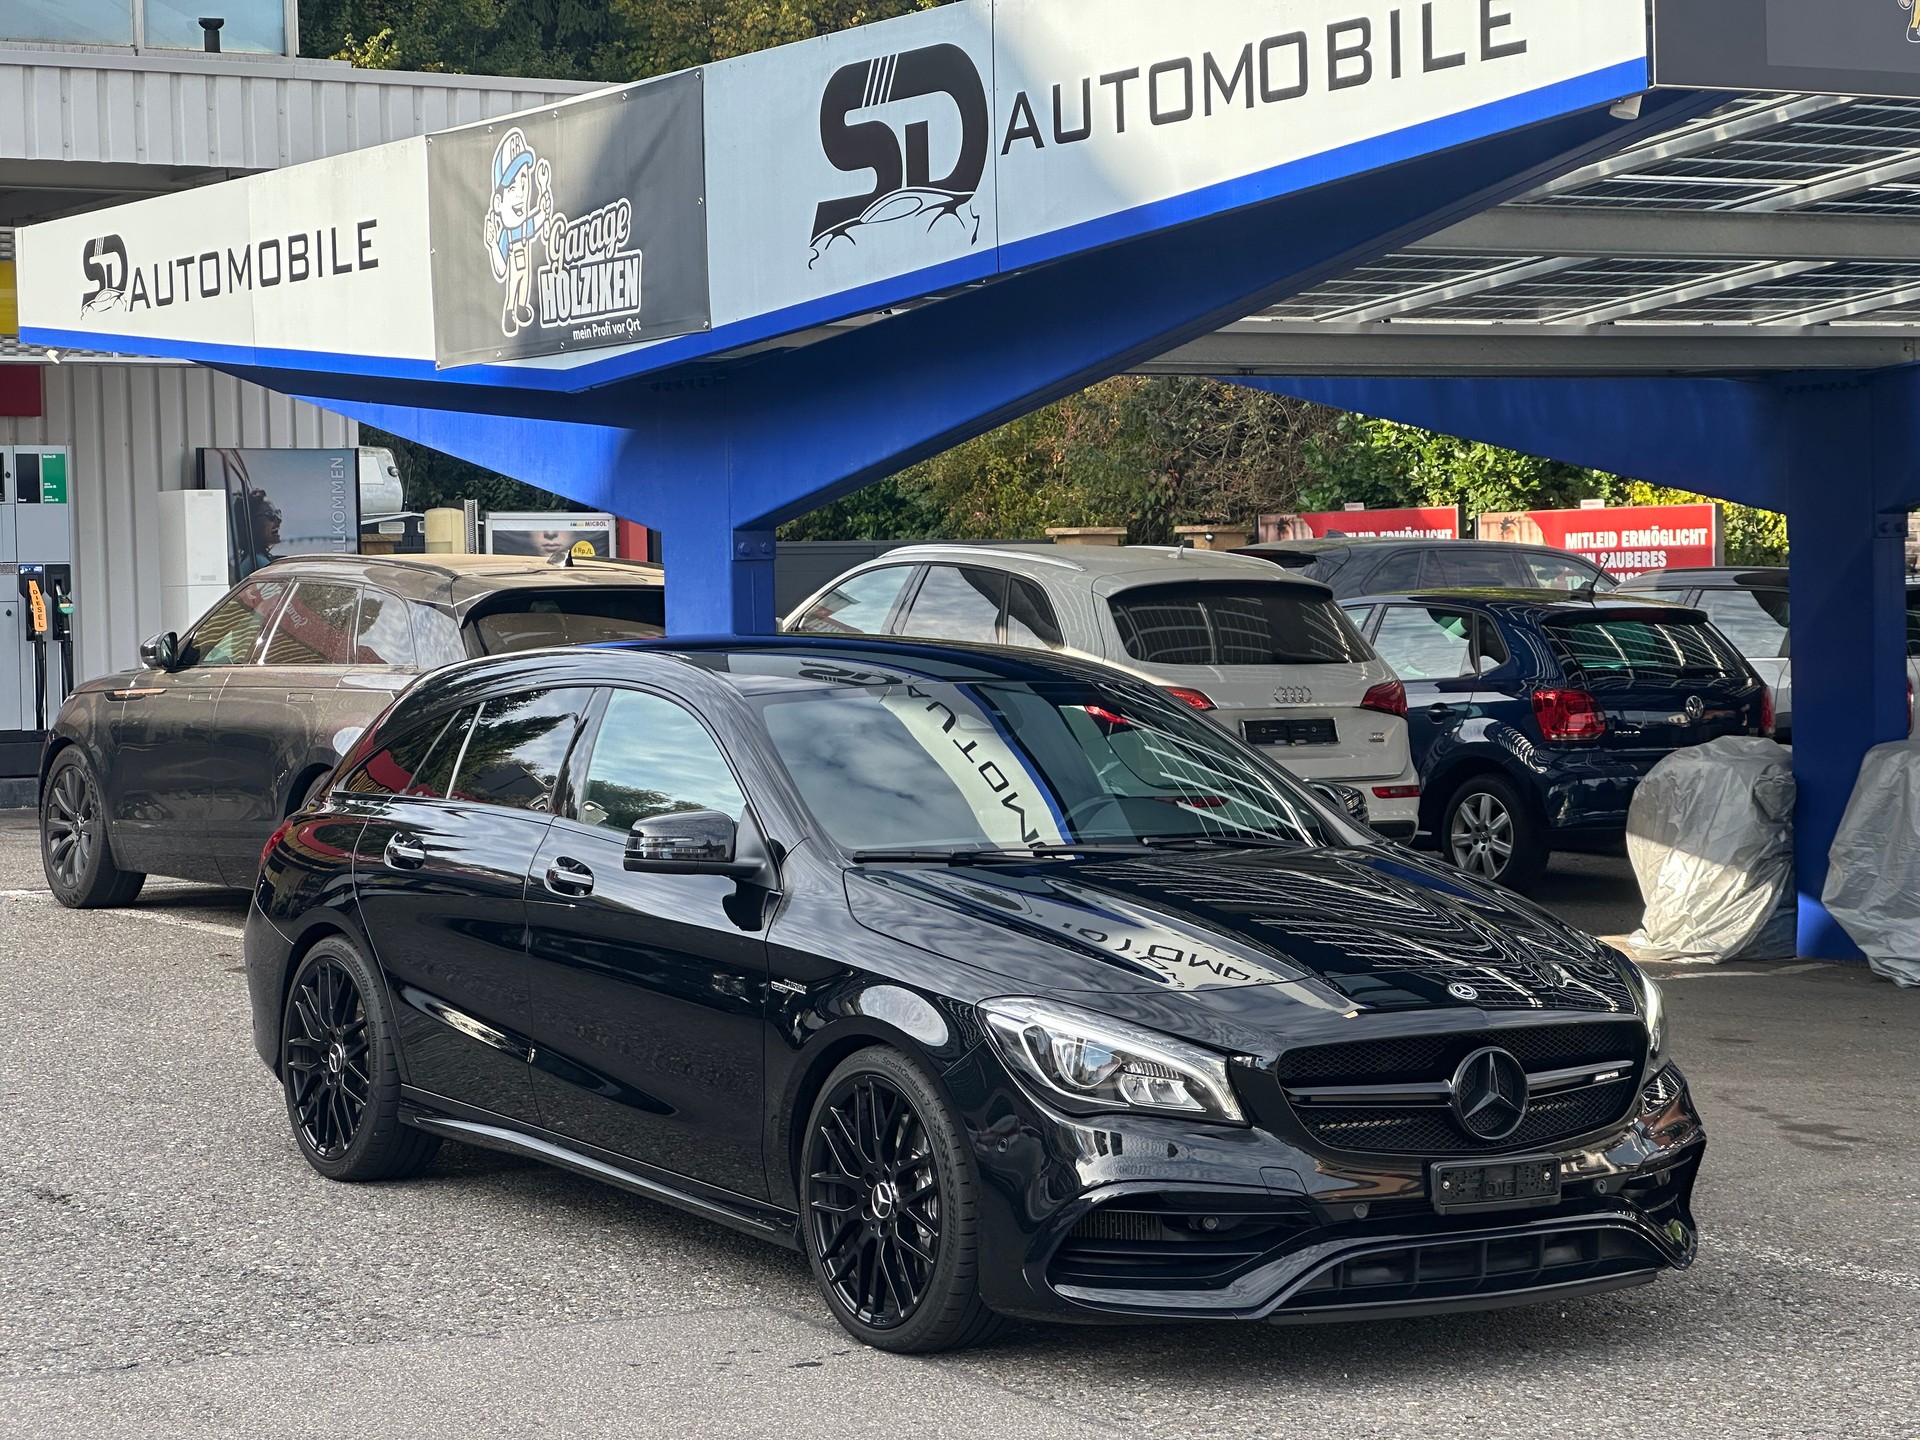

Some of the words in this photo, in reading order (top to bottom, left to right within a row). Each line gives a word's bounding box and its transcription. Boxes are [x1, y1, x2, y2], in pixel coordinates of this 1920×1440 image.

[809, 43, 989, 247] SD
[1001, 0, 1528, 156] AUTOMOBILE
[129, 219, 379, 312] AUTOMOBILE
[550, 203, 630, 277] Garage
[540, 256, 639, 322] HOLZIKEN
[573, 325, 592, 340] mein
[592, 320, 611, 337] Profi
[612, 323, 625, 334] vor
[626, 318, 641, 332] Ort
[330, 457, 346, 553] LLKOMMEN
[1565, 530, 1618, 549] MITLEID
[1621, 525, 1708, 547] ERMÖGLICHT
[1600, 550, 1667, 568] SAUBERES
[32, 589, 44, 628] DIESEL
[881, 1056, 926, 1100] SportContact
